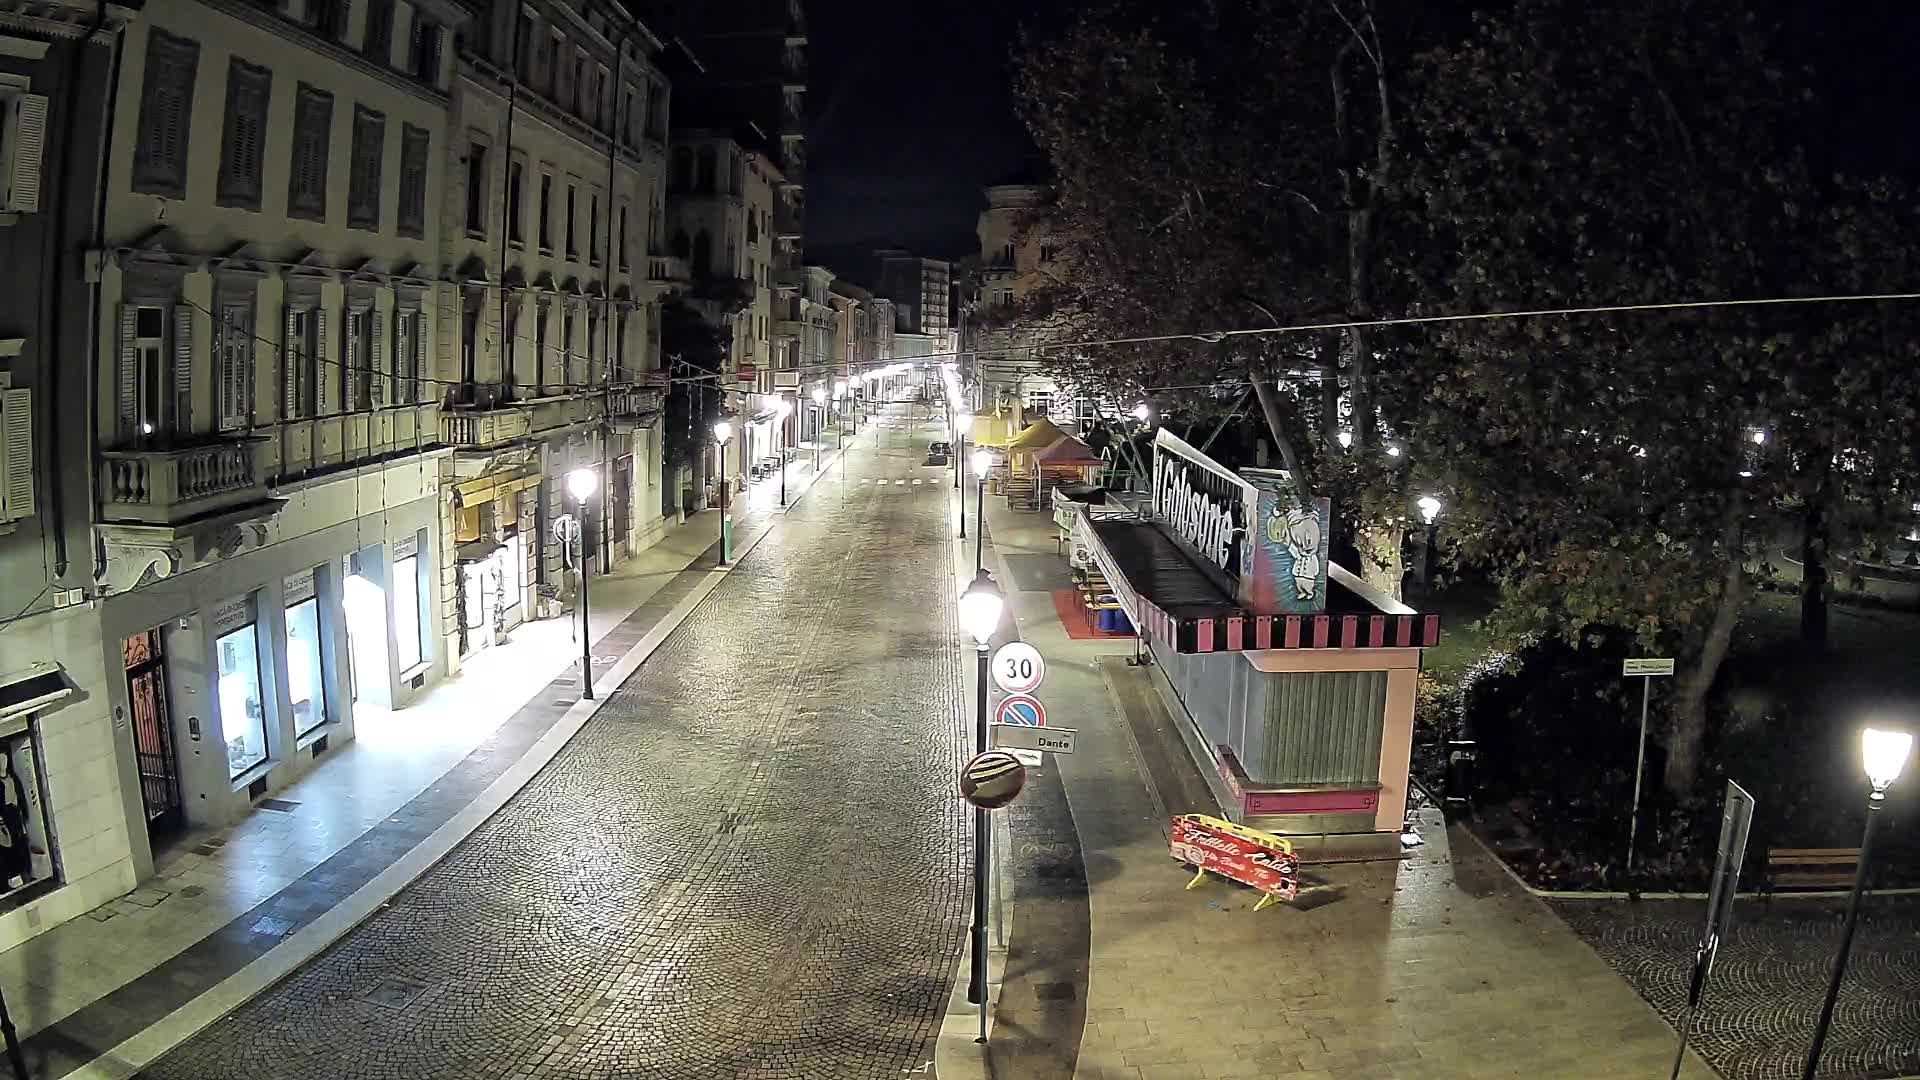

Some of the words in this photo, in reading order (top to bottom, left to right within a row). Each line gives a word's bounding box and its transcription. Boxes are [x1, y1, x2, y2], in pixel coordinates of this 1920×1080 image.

[1163, 458, 1233, 570] Golosone
[1007, 659, 1032, 679] 30
[1038, 737, 1069, 749] Dante
